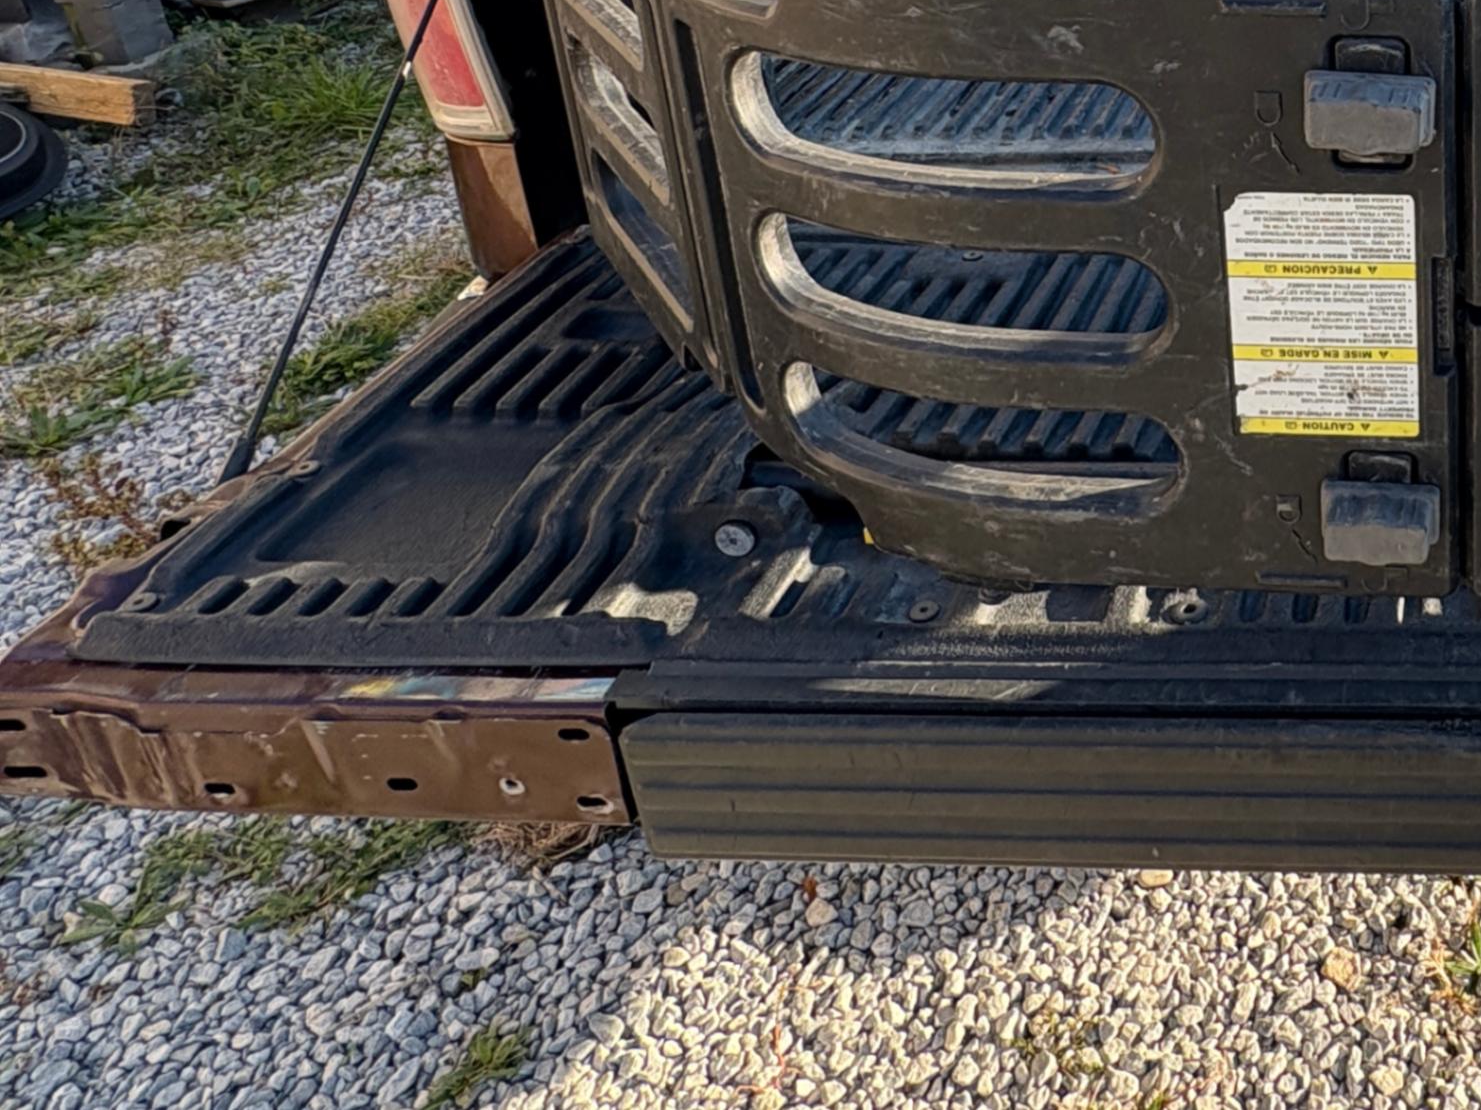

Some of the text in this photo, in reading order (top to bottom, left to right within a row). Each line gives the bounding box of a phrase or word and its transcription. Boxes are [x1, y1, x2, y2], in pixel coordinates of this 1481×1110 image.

[1282, 265, 1362, 274] PRECAUCION
[1278, 349, 1373, 359] MISE EN GARDE
[1302, 421, 1355, 431] CAUTION
